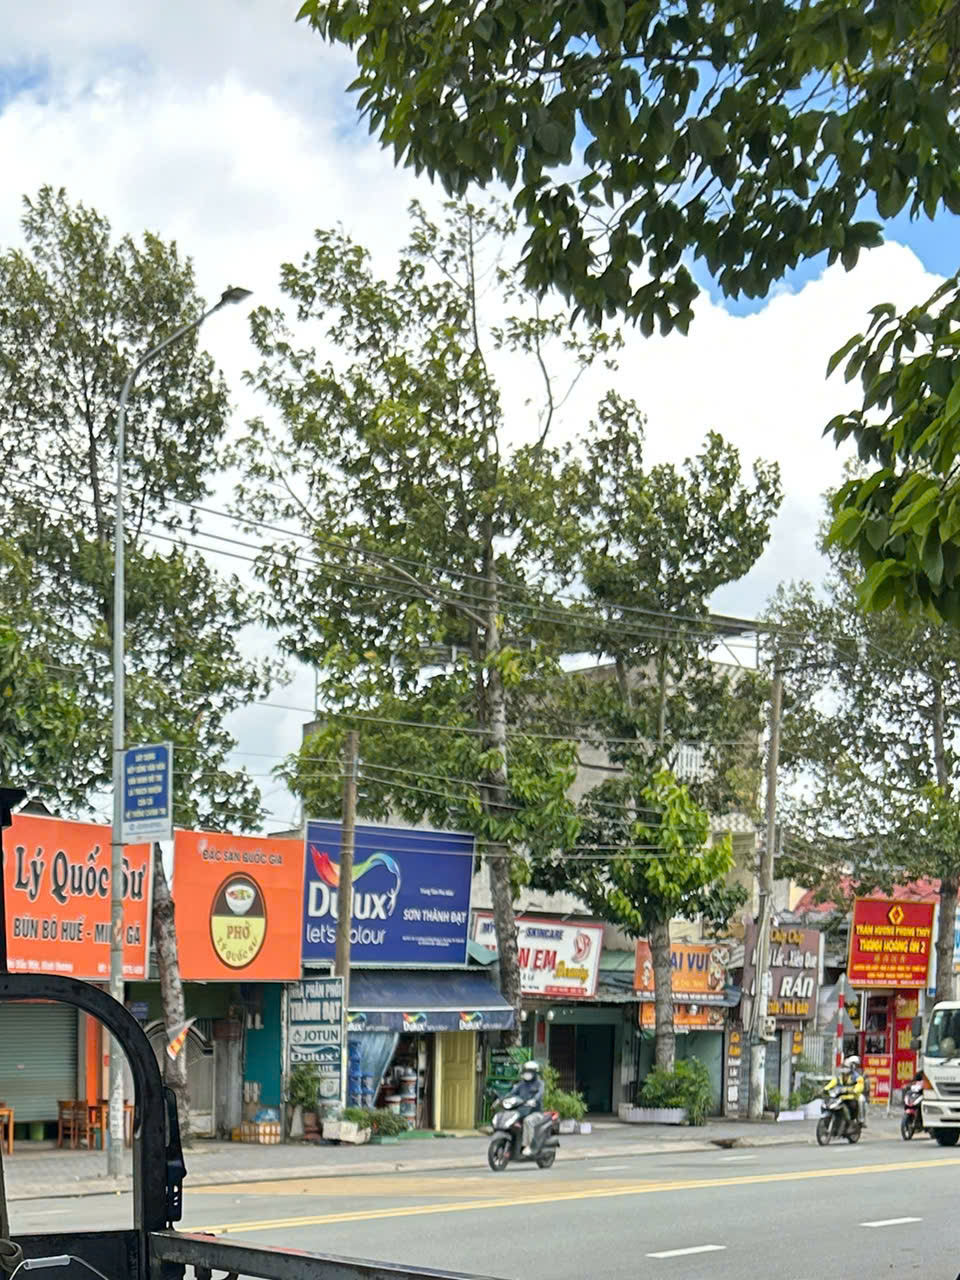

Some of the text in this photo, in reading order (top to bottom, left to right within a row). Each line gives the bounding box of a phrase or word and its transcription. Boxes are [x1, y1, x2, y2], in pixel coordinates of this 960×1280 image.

[15, 846, 45, 901] Lý
[52, 846, 108, 903] Quốc
[403, 907, 467, 926] SƠN THÀNH ĐẠT
[14, 915, 38, 938] BÚN
[42, 917, 57, 940] BÒ
[62, 914, 83, 942] HUẾ
[226, 919, 251, 940] PHỞ
[306, 923, 336, 944] let's
[349, 924, 386, 945] olour
[526, 927, 564, 940] SKINCARE
[920, 941, 926, 953] 2
[533, 948, 557, 970] EM
[403, 1020, 425, 1032] Dulux
[459, 1020, 480, 1031] Dulux
[304, 1030, 338, 1042] JOTUN
[290, 1051, 334, 1062] Dulux
